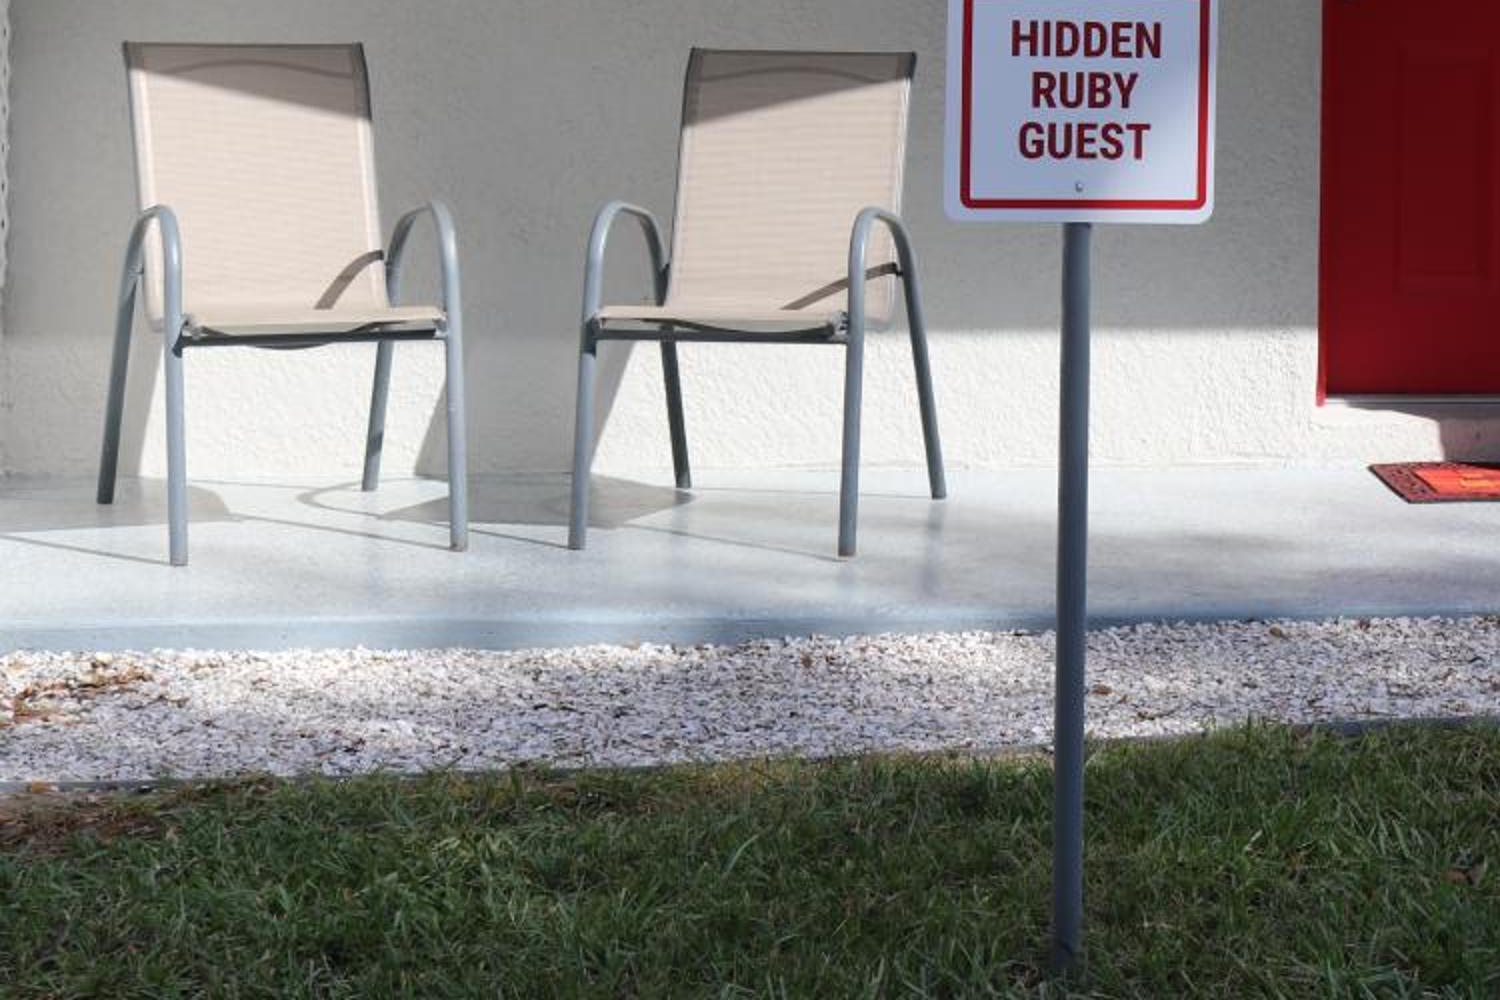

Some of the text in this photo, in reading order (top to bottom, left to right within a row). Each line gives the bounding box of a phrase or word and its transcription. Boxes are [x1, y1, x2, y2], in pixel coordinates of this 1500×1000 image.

[1011, 20, 1162, 59] HIDDEN
[1031, 71, 1138, 109] RUBY
[1018, 122, 1151, 160] GUEST
